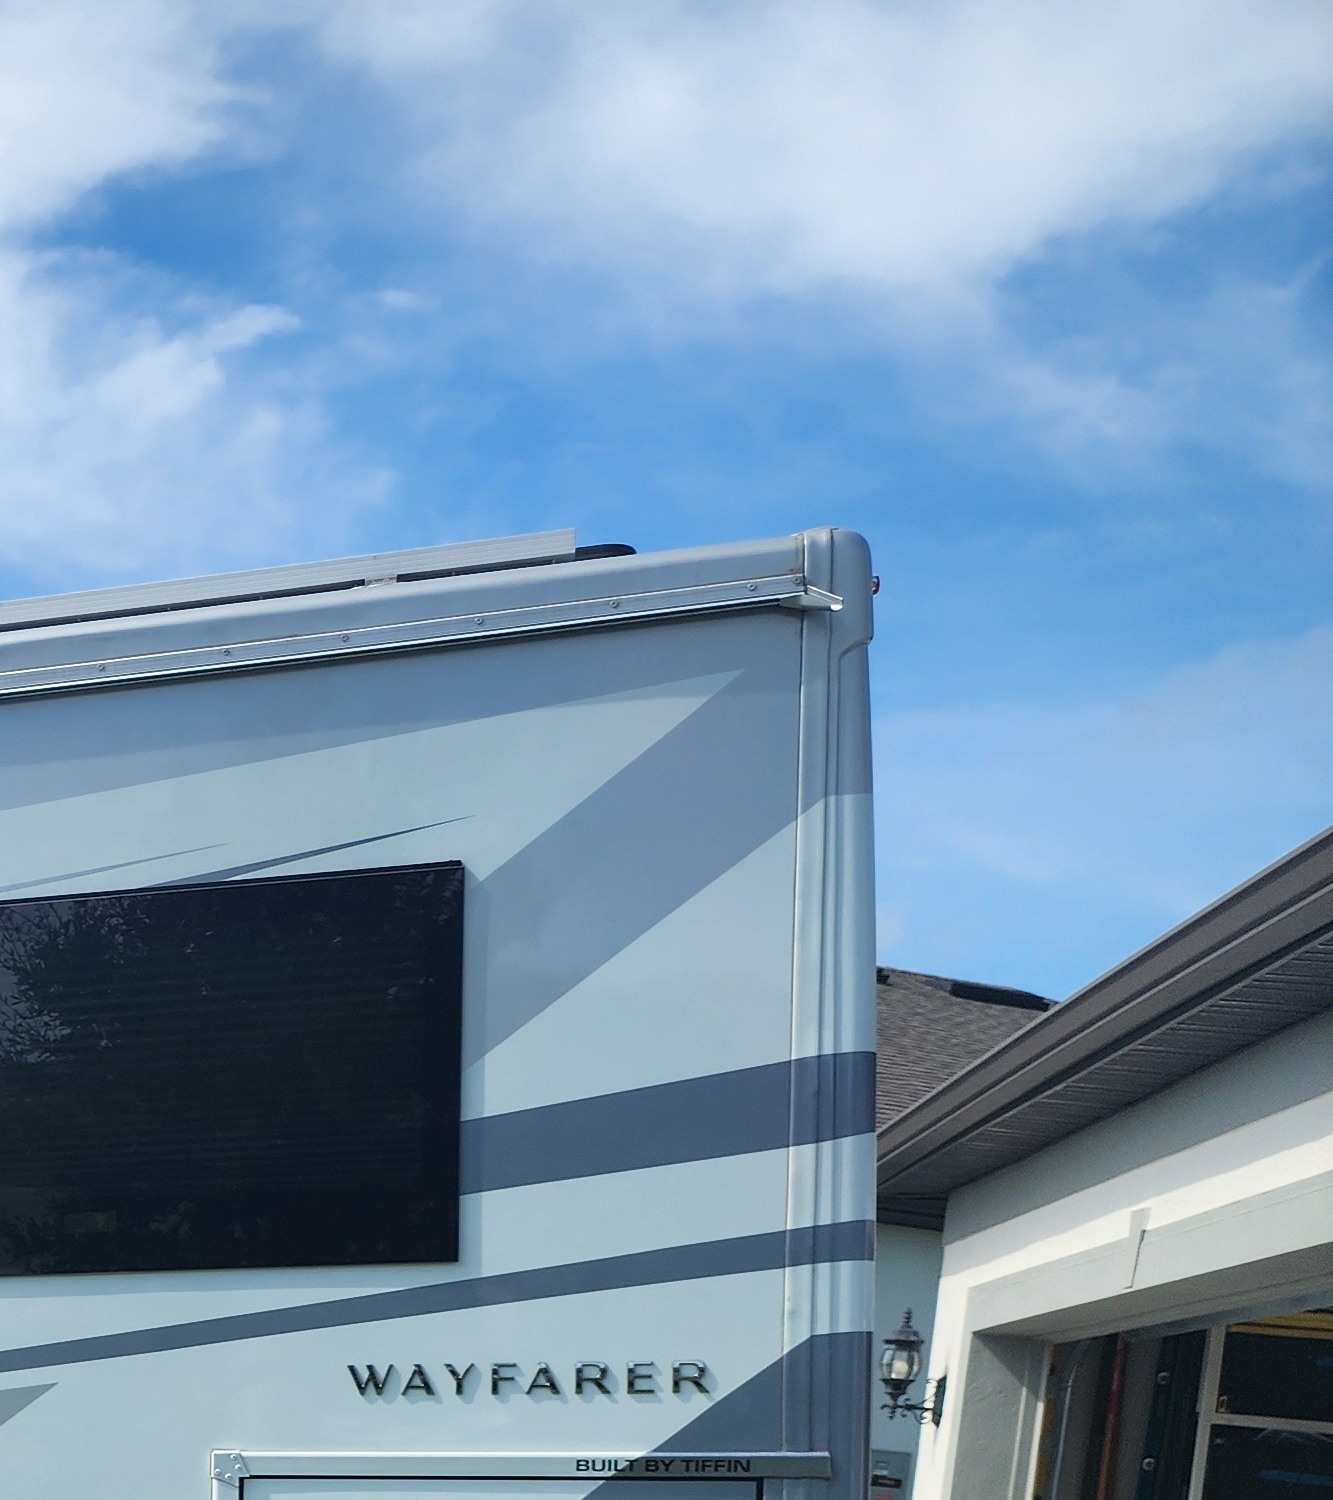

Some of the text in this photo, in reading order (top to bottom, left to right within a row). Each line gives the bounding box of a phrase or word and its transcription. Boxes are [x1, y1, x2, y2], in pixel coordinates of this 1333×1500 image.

[347, 1360, 711, 1397] WAYFARER
[575, 1459, 751, 1473] BUILT BY TIFFIN
